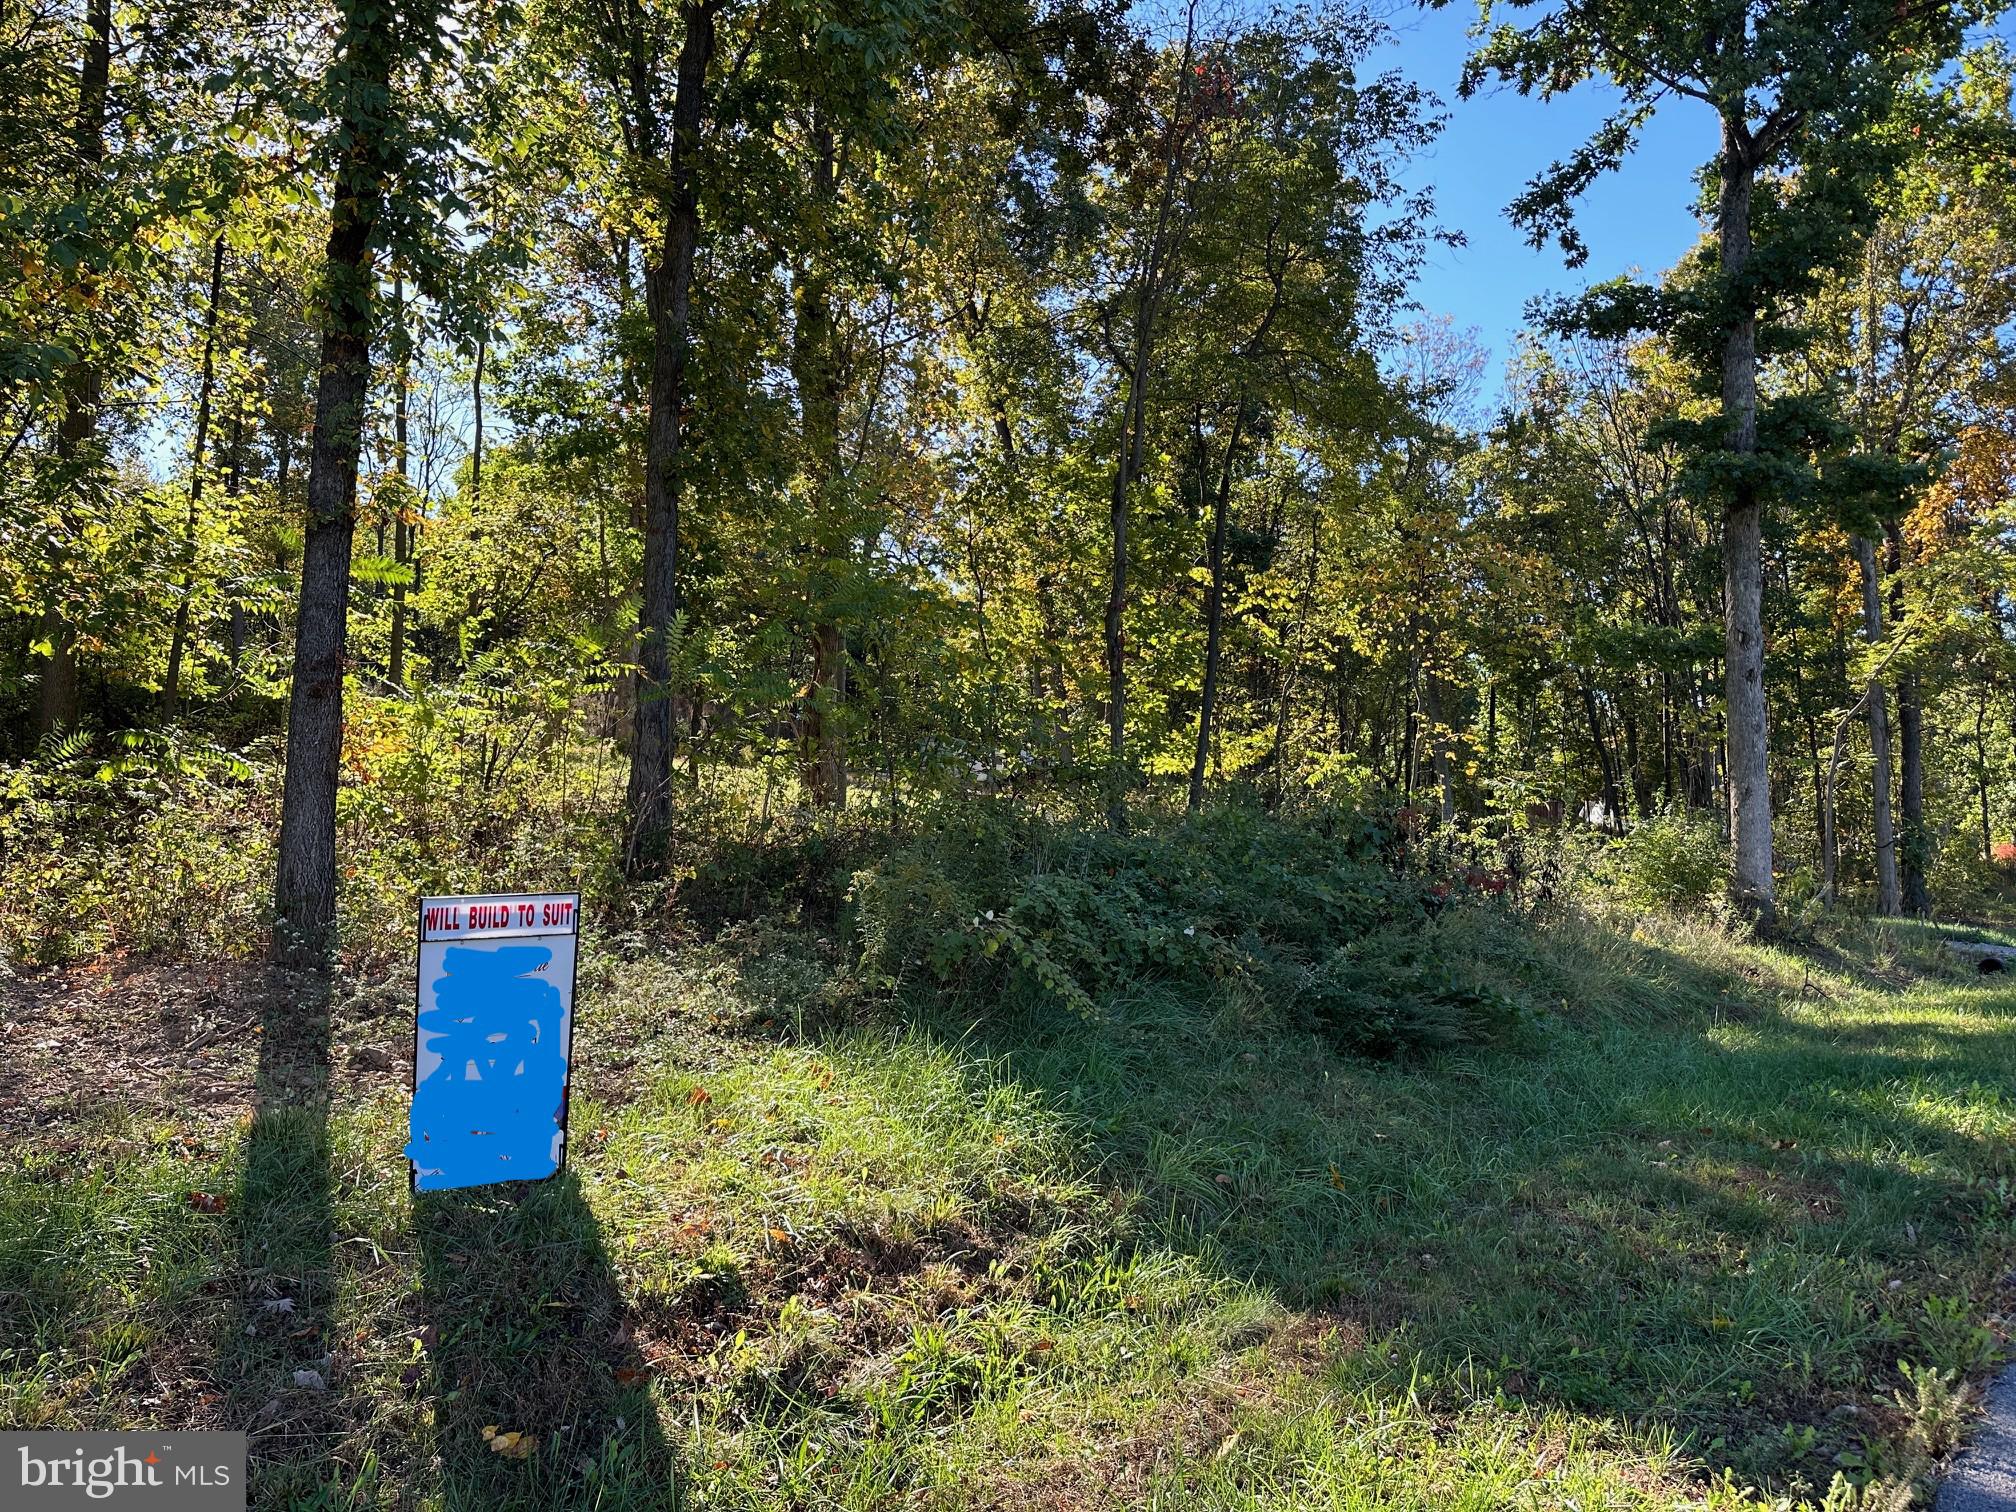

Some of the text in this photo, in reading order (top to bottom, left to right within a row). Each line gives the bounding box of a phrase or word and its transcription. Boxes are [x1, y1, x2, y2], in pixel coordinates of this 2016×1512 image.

[426, 903, 573, 931] WILL BUILD TO SUIT
